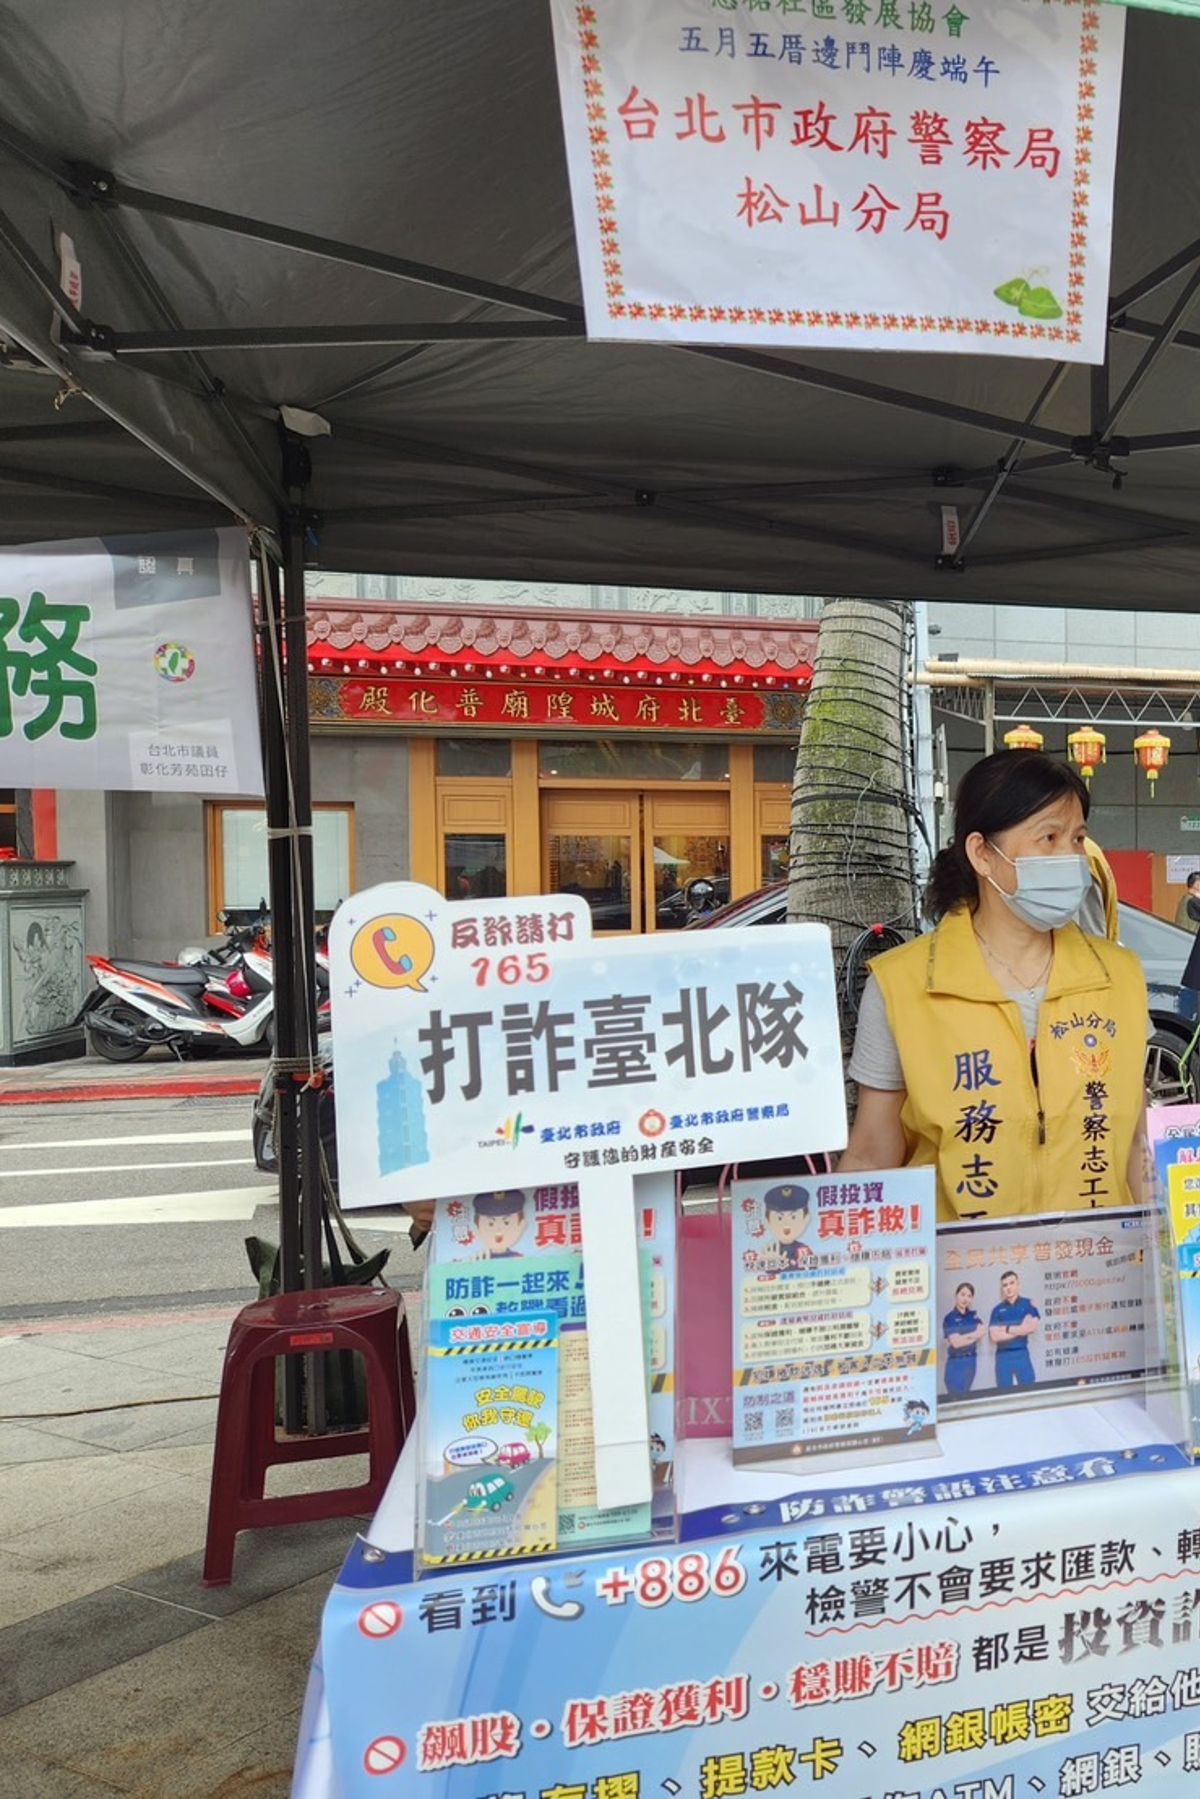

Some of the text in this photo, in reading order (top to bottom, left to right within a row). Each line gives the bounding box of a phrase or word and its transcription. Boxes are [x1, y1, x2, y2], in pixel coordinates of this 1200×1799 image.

[711, 0, 971, 39] 社區發展協會
[617, 86, 1062, 179] 台北市政府警察局
[737, 176, 950, 241] 松山分局
[148, 743, 220, 759] 台北市議員
[469, 951, 552, 988] 165
[417, 978, 810, 1104] 打詐臺北隊
[1050, 1011, 1117, 1040] 松山分局
[540, 1120, 622, 1145] 臺北市政府
[668, 1102, 790, 1131] 臺北市政府警察局
[953, 1049, 1003, 1219] 服務志
[563, 1136, 715, 1169] 守護您的財產安全
[1079, 1080, 1110, 1209] 警察志工
[816, 1181, 884, 1208] 假投資
[818, 1203, 921, 1239] 真詐欺！
[451, 1320, 548, 1342] 交通安全宣導
[418, 1516, 1001, 1634] 看到 +886 來電要小心，
[971, 1625, 1051, 1672] 都是
